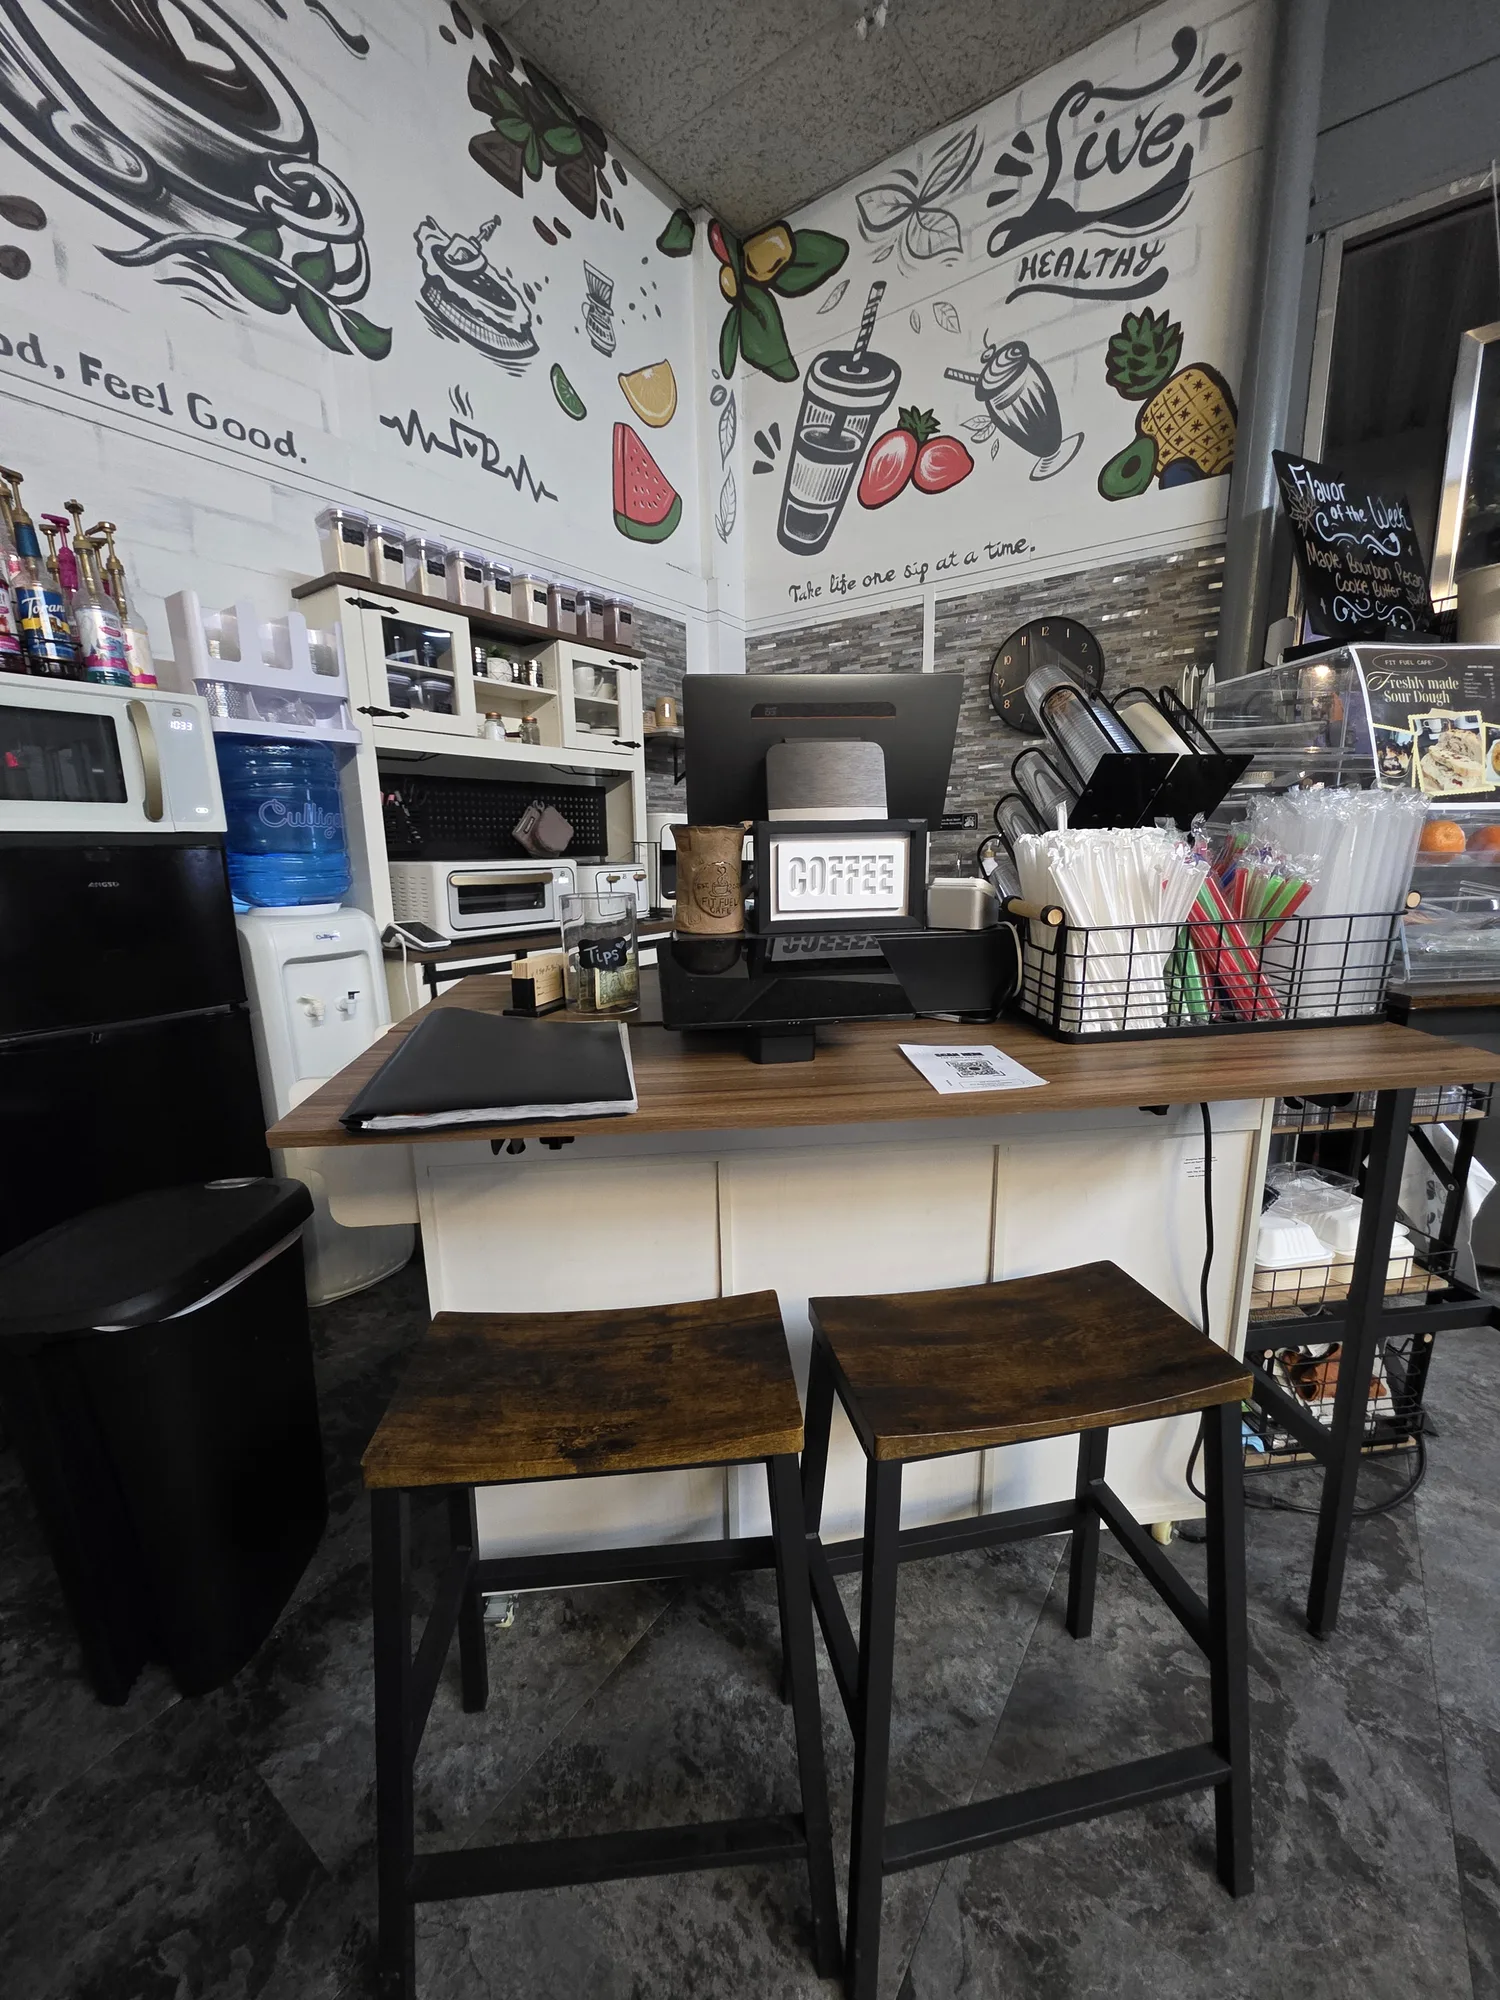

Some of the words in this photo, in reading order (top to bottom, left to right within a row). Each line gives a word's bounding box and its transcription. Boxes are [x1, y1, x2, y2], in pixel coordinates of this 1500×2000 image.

[1018, 238, 1167, 283] HEALTHY
[79, 351, 173, 416] Feel
[187, 392, 307, 464] Good.
[1288, 463, 1346, 503] Flavor
[1330, 504, 1345, 521] of
[1345, 504, 1367, 522] the
[1366, 495, 1411, 531] Week
[788, 580, 822, 603] Take
[829, 573, 856, 595] life
[862, 569, 896, 588] one
[903, 562, 929, 584] sip
[936, 550, 959, 571] at
[963, 551, 979, 565] a
[983, 538, 1036, 560] time.
[1305, 541, 1342, 572] Maple
[1346, 552, 1392, 580] Bourbon
[1371, 580, 1402, 598] Butter
[1041, 626, 1050, 636] 12
[1081, 643, 1088, 653] 2
[1087, 665, 1094, 674] 3
[1366, 671, 1425, 692] Freshly
[1427, 676, 1460, 690] made
[1003, 699, 1010, 708] 8
[1383, 690, 1411, 703] Sour
[1413, 690, 1451, 707] Dough
[788, 855, 894, 897] COFFEE
[583, 945, 620, 965] Tips
